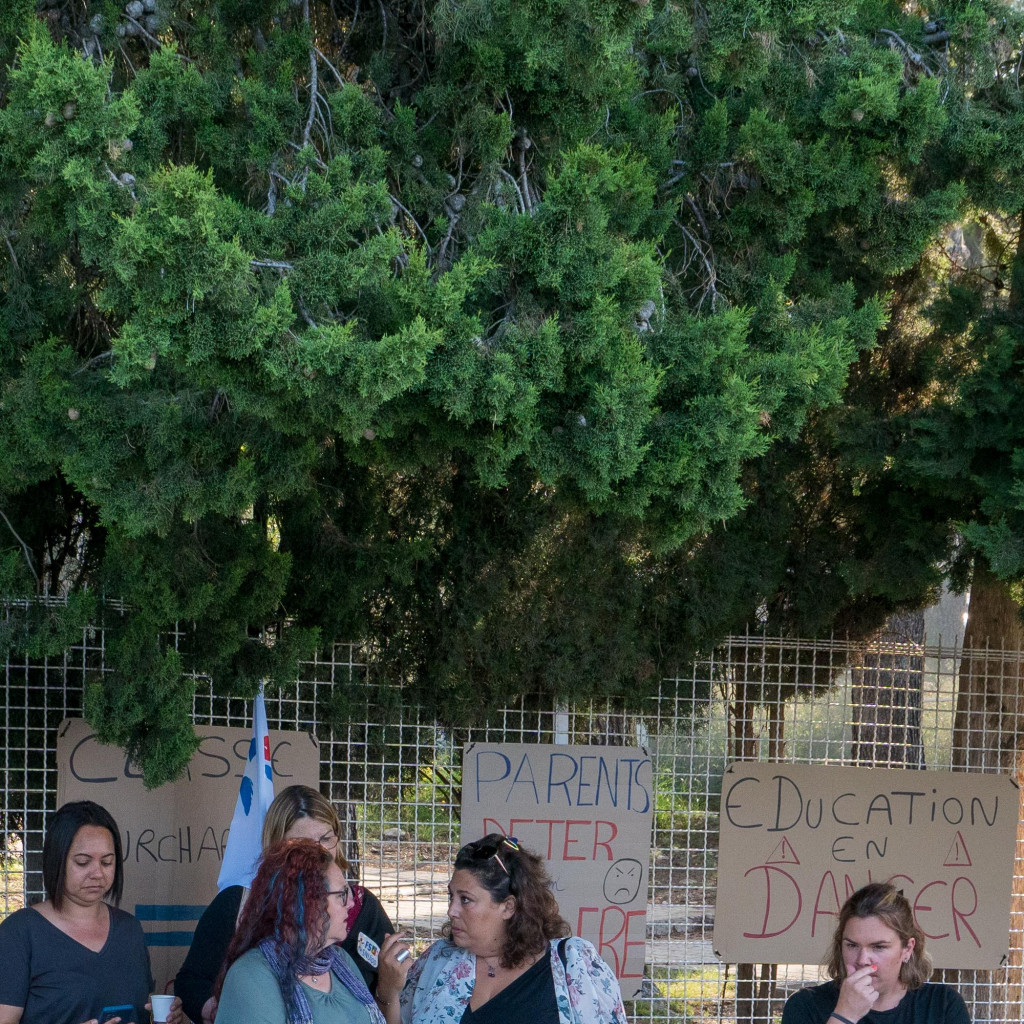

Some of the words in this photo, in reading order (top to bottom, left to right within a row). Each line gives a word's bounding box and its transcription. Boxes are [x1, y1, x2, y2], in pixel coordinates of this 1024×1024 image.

[69, 733, 293, 783] CLSSE
[476, 751, 652, 814] PARENTS
[831, 836, 889, 863] EN
[743, 865, 982, 949] DAER
